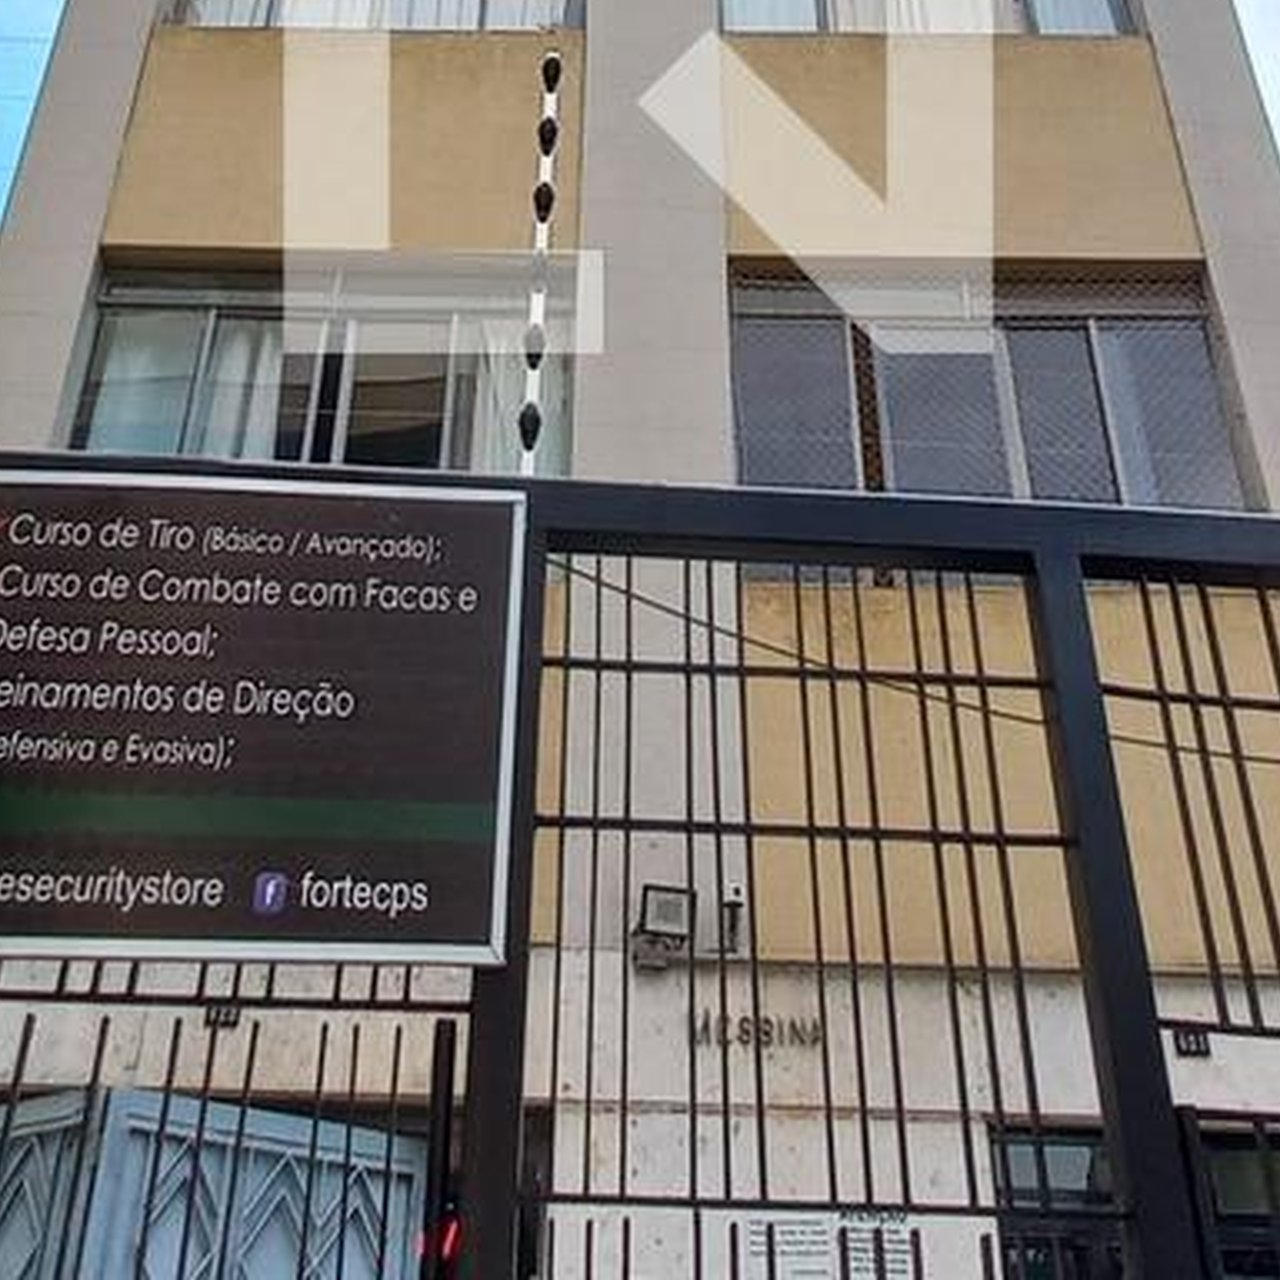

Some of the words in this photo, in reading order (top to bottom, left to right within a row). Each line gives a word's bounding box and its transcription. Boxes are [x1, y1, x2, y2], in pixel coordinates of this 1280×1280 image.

[7, 513, 93, 548] Curso
[98, 517, 140, 549] de
[147, 519, 195, 551] Tiro
[202, 524, 284, 556] (Básico
[287, 531, 303, 556] /
[304, 532, 444, 563] Avançado);
[88, 568, 129, 601] de
[137, 568, 282, 606] Combate
[289, 580, 357, 608] com
[363, 577, 452, 612] Facas
[456, 586, 479, 612] e
[97, 620, 220, 658] Pessoal;
[182, 679, 225, 714] de
[232, 680, 356, 721] Direção
[101, 740, 120, 762] e
[125, 733, 237, 770] Evasiva);
[300, 870, 429, 918] fortecps
